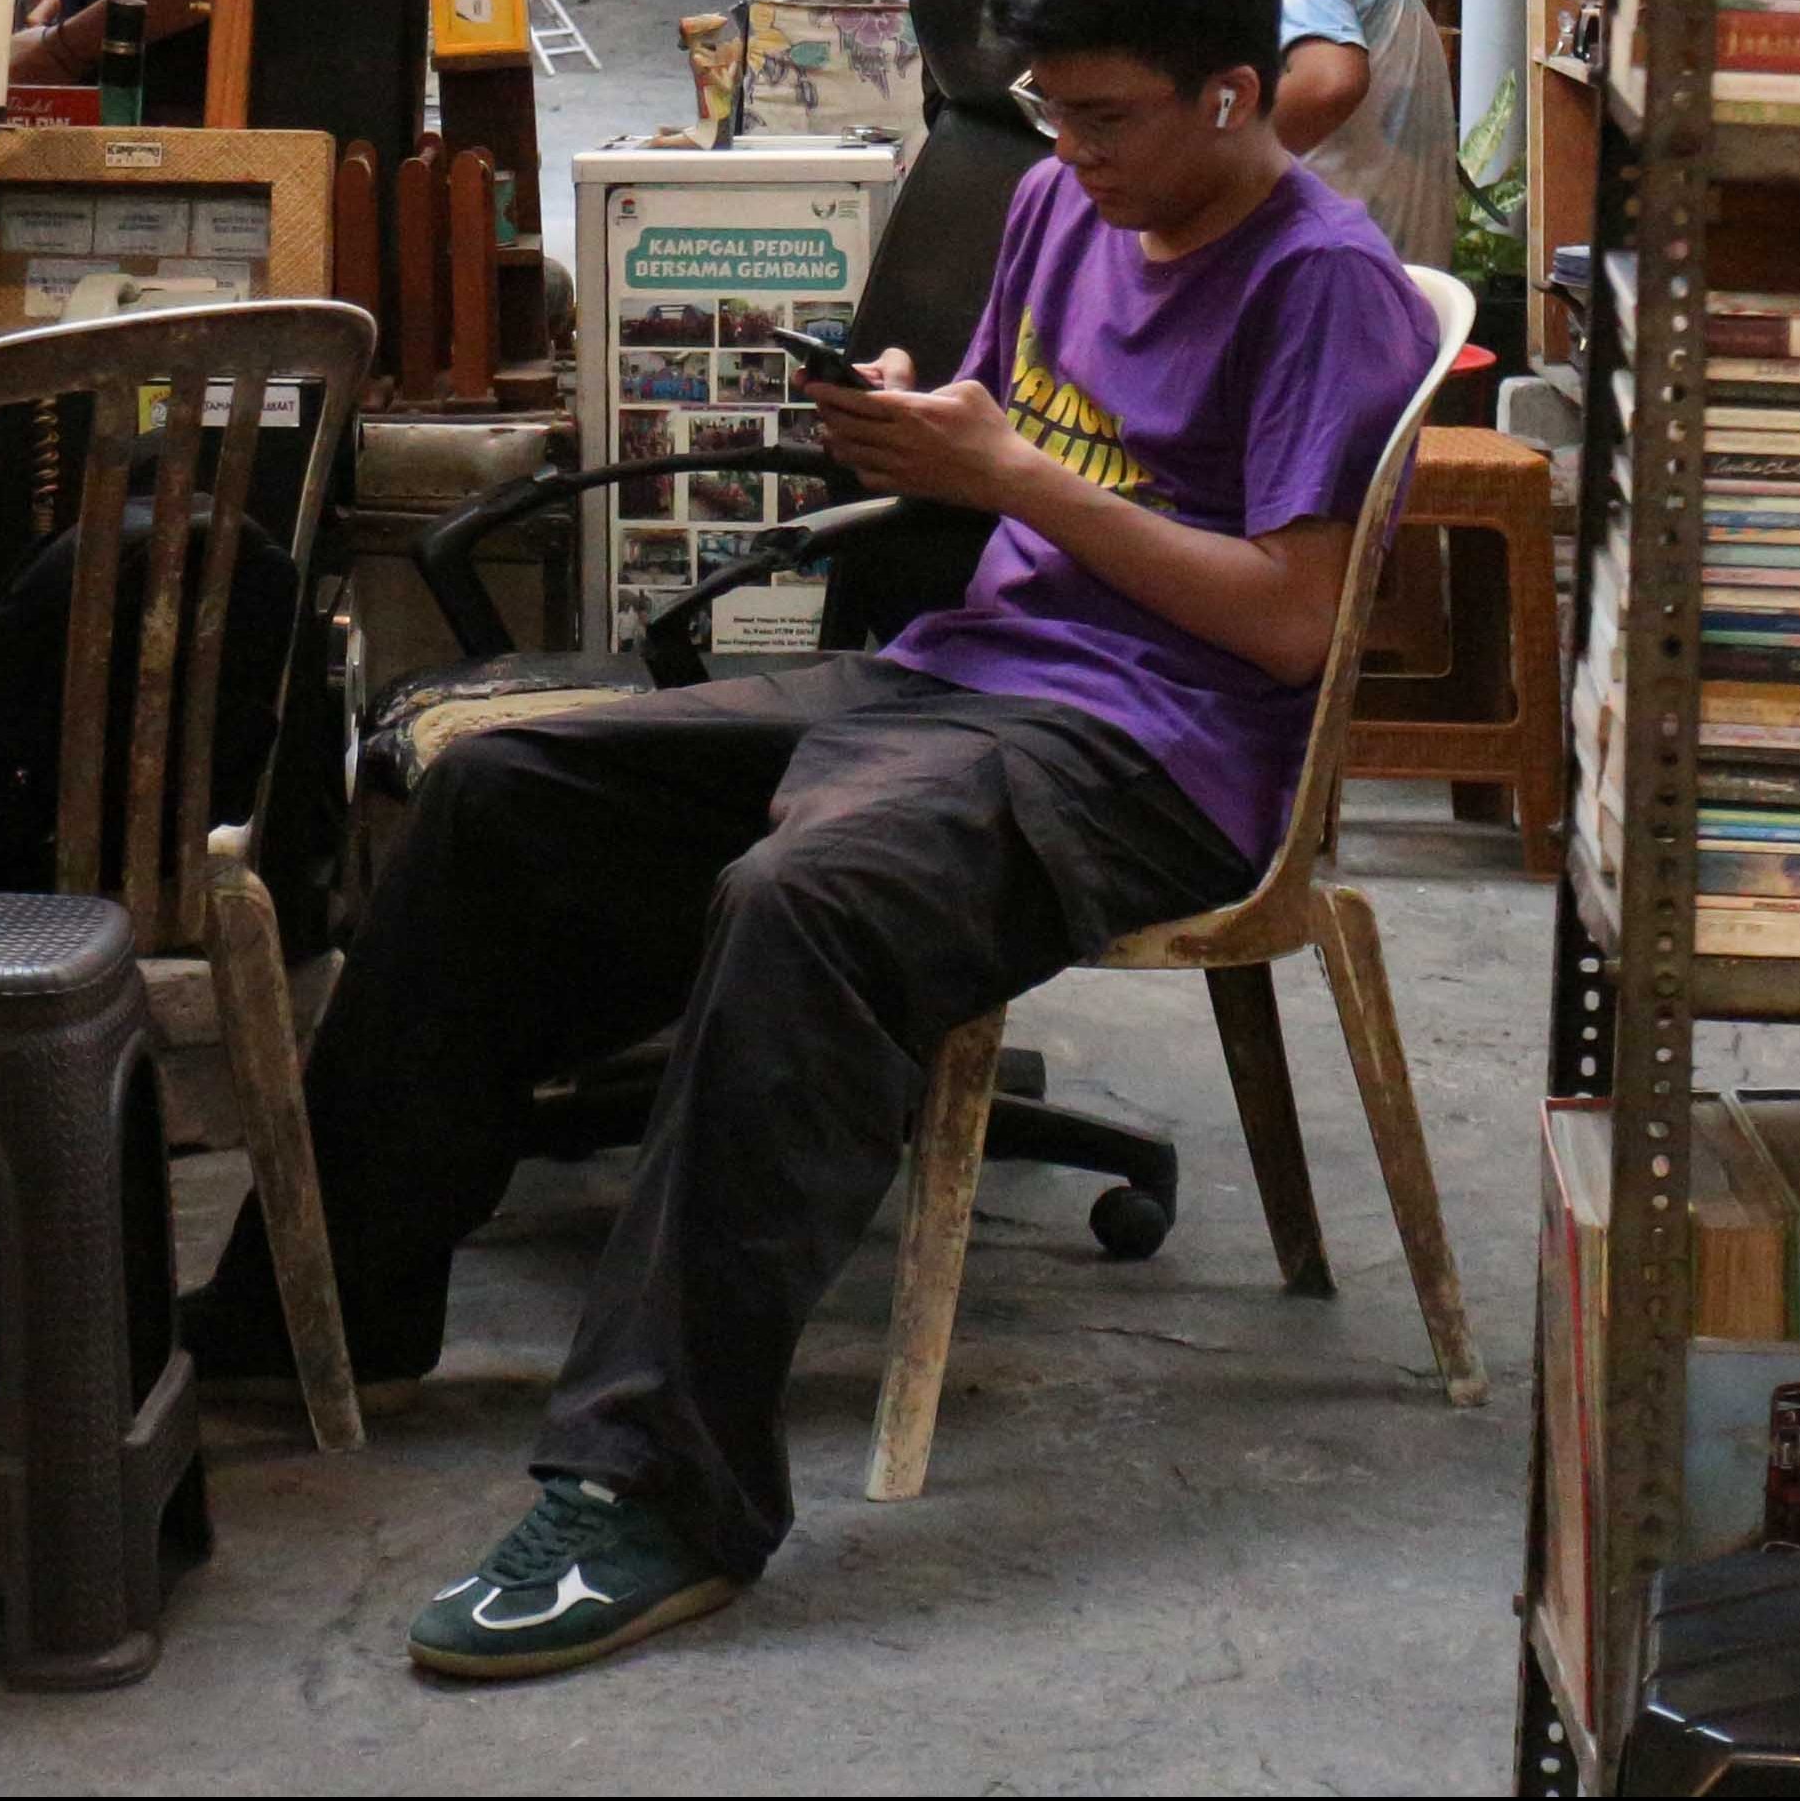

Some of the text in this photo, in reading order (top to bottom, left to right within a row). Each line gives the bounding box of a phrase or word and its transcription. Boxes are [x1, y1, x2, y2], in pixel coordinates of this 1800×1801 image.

[649, 239, 825, 257] KAMPGAL PEDULI
[635, 260, 840, 279] BERSAMA GEMBANG
